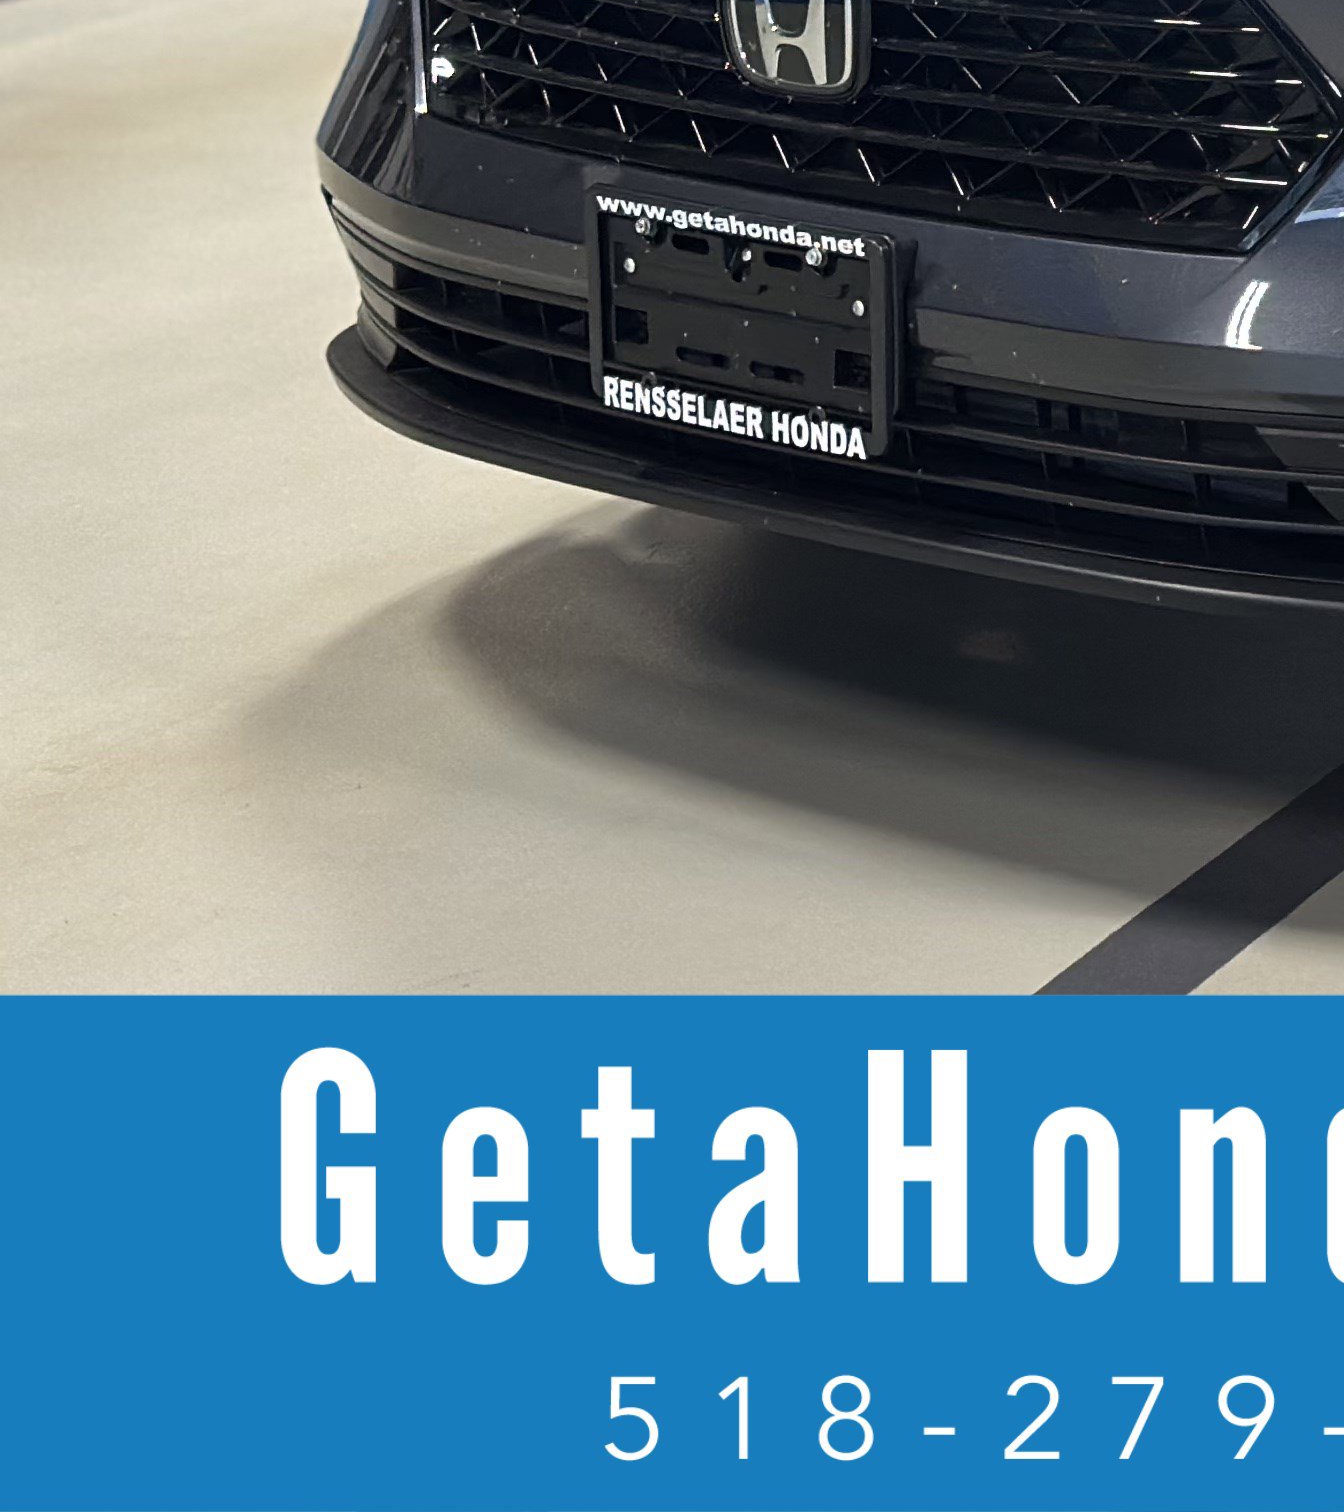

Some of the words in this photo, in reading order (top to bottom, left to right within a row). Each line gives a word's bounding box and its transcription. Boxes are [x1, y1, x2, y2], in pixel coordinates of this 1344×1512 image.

[596, 195, 866, 257] www.getahonda.net
[603, 375, 764, 439] RENSSELAER
[771, 410, 867, 460] HONDA
